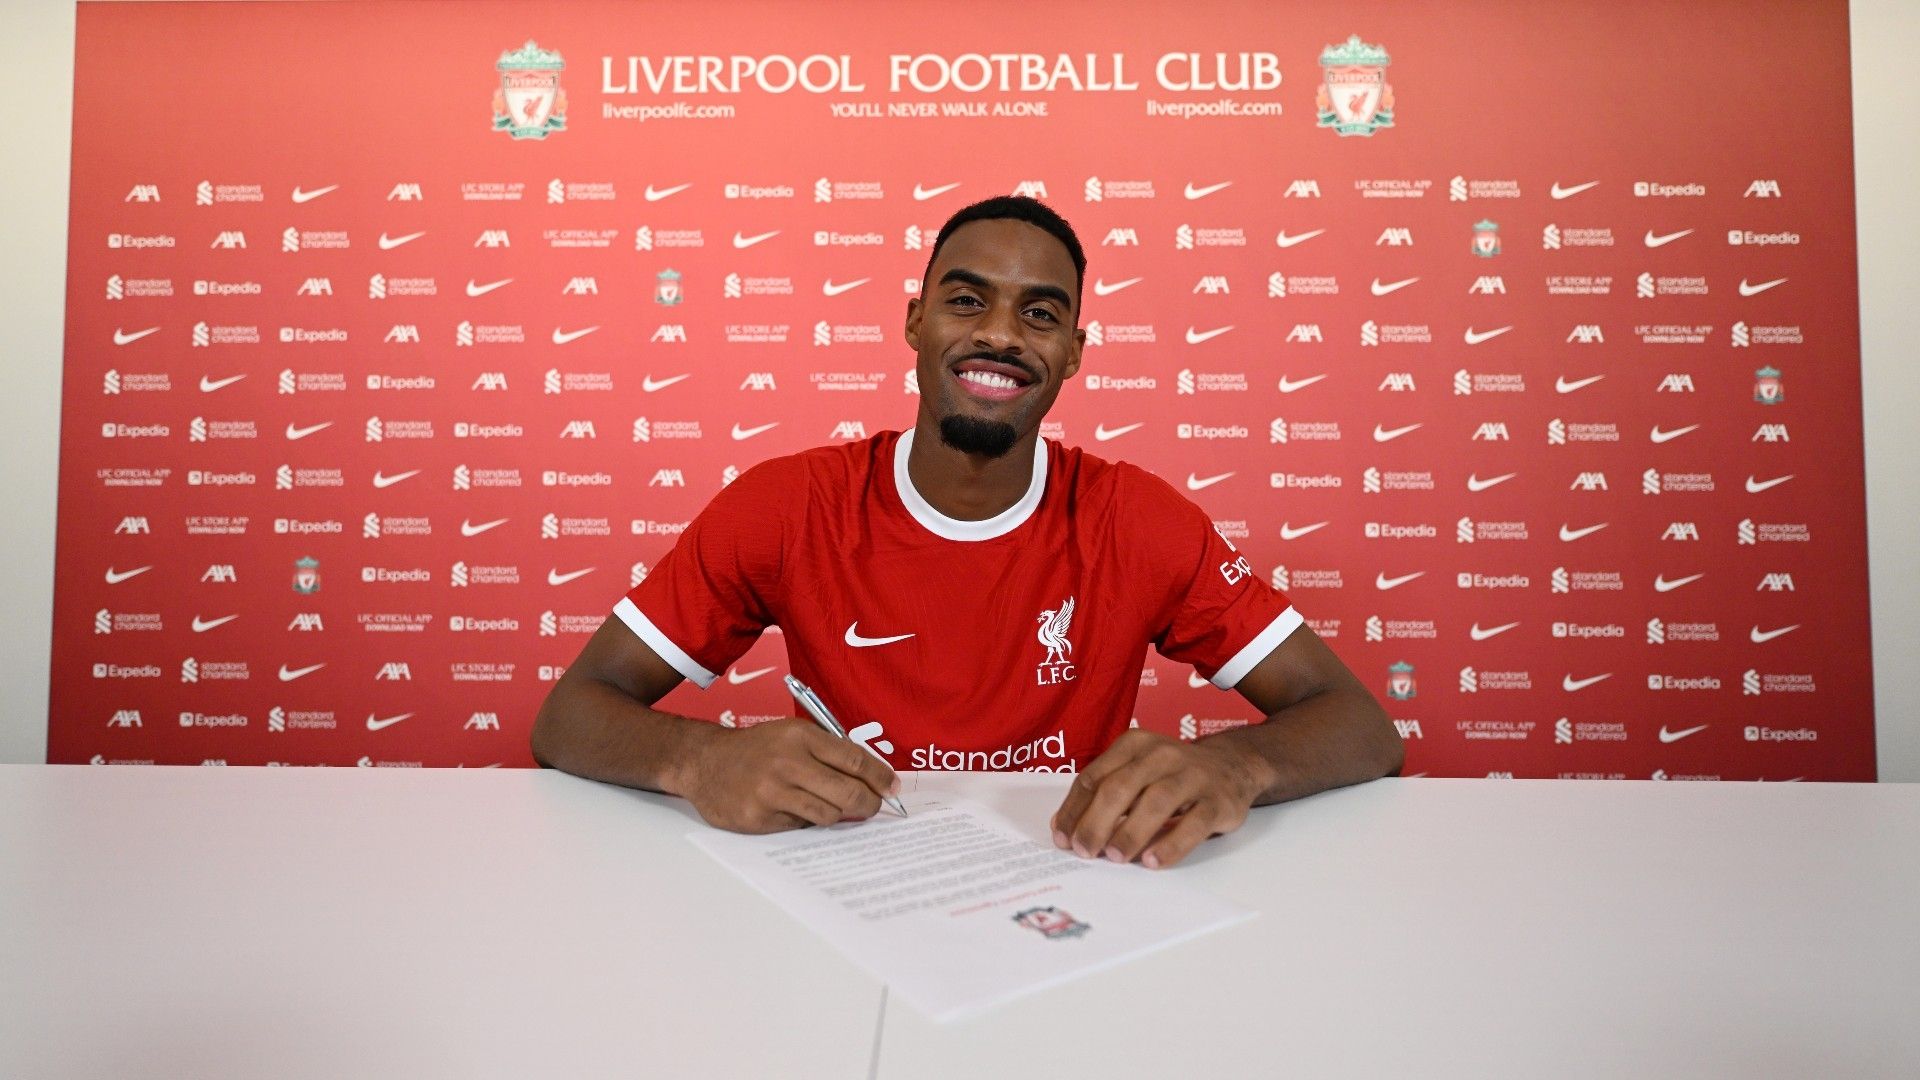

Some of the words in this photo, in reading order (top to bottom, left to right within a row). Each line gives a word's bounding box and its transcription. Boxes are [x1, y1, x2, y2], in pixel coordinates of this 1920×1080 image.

[602, 54, 866, 95] LIVERPOOL
[890, 53, 1139, 93] FOOTBALL
[1156, 52, 1283, 93] CLUB
[602, 102, 735, 122] liverpoolfc.com
[888, 103, 938, 117] NEVER
[942, 103, 988, 116] WALK
[992, 102, 1048, 116] ALONE
[1146, 99, 1283, 119] liverpoolfc.com
[216, 185, 261, 194] standard
[387, 183, 423, 201] AXA
[740, 185, 794, 199] Expedia
[834, 182, 881, 191] standard
[1283, 180, 1321, 198] AXA
[1470, 180, 1518, 189] standard
[1650, 182, 1705, 198] Expedia
[1743, 180, 1781, 198] AXA
[125, 184, 161, 202] AXA
[215, 193, 264, 202] chartered
[834, 190, 884, 199] chartered
[1470, 189, 1521, 198] chartered
[210, 231, 247, 249] AXA
[474, 230, 510, 248] AXA
[655, 230, 701, 239] standard
[830, 232, 884, 247] Expedia
[1101, 228, 1139, 246] AXA
[1376, 227, 1413, 246] AXA
[1563, 228, 1611, 237] standard
[1745, 231, 1800, 247] Expedia
[123, 234, 175, 249] Expedia
[655, 238, 704, 247] chartered
[1563, 237, 1614, 246] chartered
[297, 278, 333, 296] AXA
[389, 278, 434, 287] standard
[562, 277, 598, 295] AXA
[1192, 276, 1230, 294] AXA
[1288, 276, 1336, 285] standard
[1468, 276, 1506, 294] AXA
[1593, 276, 1612, 286] APP
[209, 281, 261, 296] Expedia
[388, 286, 437, 295] chartered
[1288, 285, 1339, 294] chartered
[212, 326, 257, 335] standard
[295, 328, 347, 343] Expedia
[384, 325, 420, 343] AXA
[650, 324, 687, 342] AXA
[833, 325, 880, 334] standard
[1286, 324, 1323, 343] AXA
[1381, 325, 1429, 334] standard
[1566, 325, 1604, 343] AXA
[1694, 325, 1713, 334] APP
[211, 334, 260, 343] chartered
[833, 333, 883, 342] chartered
[1381, 333, 1432, 342] chartered
[123, 374, 168, 383] standard
[382, 376, 435, 390] Expedia
[472, 372, 508, 391] AXA
[564, 373, 610, 382] standard
[740, 373, 776, 390] AXA
[1102, 376, 1156, 391] Expedia
[1378, 373, 1416, 391] AXA
[1474, 374, 1522, 383] standard
[1656, 374, 1695, 392] AXA
[122, 382, 171, 391] chartered
[564, 381, 613, 390] chartered
[1474, 382, 1525, 391] chartered
[117, 424, 170, 438] Expedia
[385, 421, 431, 430] standard
[470, 423, 523, 438] Expedia
[560, 420, 596, 439] AXA
[829, 421, 866, 439] AXA
[1193, 424, 1248, 440] Expedia
[1290, 422, 1338, 431] standard
[1472, 422, 1509, 441] AXA
[1751, 424, 1790, 442] AXA
[385, 429, 434, 438] chartered
[1290, 431, 1341, 440] chartered
[203, 471, 256, 486] Expedia
[296, 469, 341, 478] standard
[558, 472, 611, 487] Expedia
[648, 469, 685, 487] AXA
[1383, 472, 1431, 481] standard
[295, 477, 344, 486] chartered
[1287, 474, 1342, 489] Expedia
[1383, 480, 1434, 489] chartered
[1570, 472, 1608, 491] AXA
[114, 516, 150, 534] AXA
[231, 516, 249, 526] APP
[290, 519, 342, 534] Expedia
[383, 517, 429, 526] standard
[647, 520, 692, 536] Exped
[1477, 521, 1525, 530] standard
[383, 525, 432, 534] chartered
[1381, 523, 1436, 539] Expedia
[1477, 530, 1528, 539] chartered
[1661, 522, 1699, 541] AXA
[200, 564, 237, 583] AXA
[377, 568, 430, 583] Expedia
[471, 566, 517, 575] standard
[1572, 572, 1620, 581] standard
[471, 574, 520, 583] chartered
[1474, 573, 1529, 589] Expedia
[1572, 580, 1623, 589] chartered
[1756, 573, 1795, 591] AXA
[288, 613, 324, 631] AXA
[415, 614, 433, 623] APP
[465, 617, 519, 632] Expedia
[1386, 620, 1434, 629] standard
[1386, 629, 1437, 638] chartered
[1569, 623, 1624, 639] Expedia
[108, 664, 161, 679] Expedia
[201, 662, 246, 671] standard
[375, 662, 411, 681] AXA
[200, 670, 249, 679] chartered
[1037, 665, 1077, 685] L.F.C.
[1763, 674, 1813, 683] standard
[1664, 675, 1721, 691] Expedia
[1763, 683, 1816, 692] chartered
[107, 710, 143, 728] AXA
[195, 713, 248, 728] Expedia
[463, 712, 500, 730] AXA
[1517, 721, 1536, 731] APP
[1575, 722, 1624, 731] standard
[1394, 719, 1423, 739] XA
[1575, 731, 1627, 740] chartered
[1761, 727, 1819, 743] Expedia
[911, 730, 1065, 771] standard
